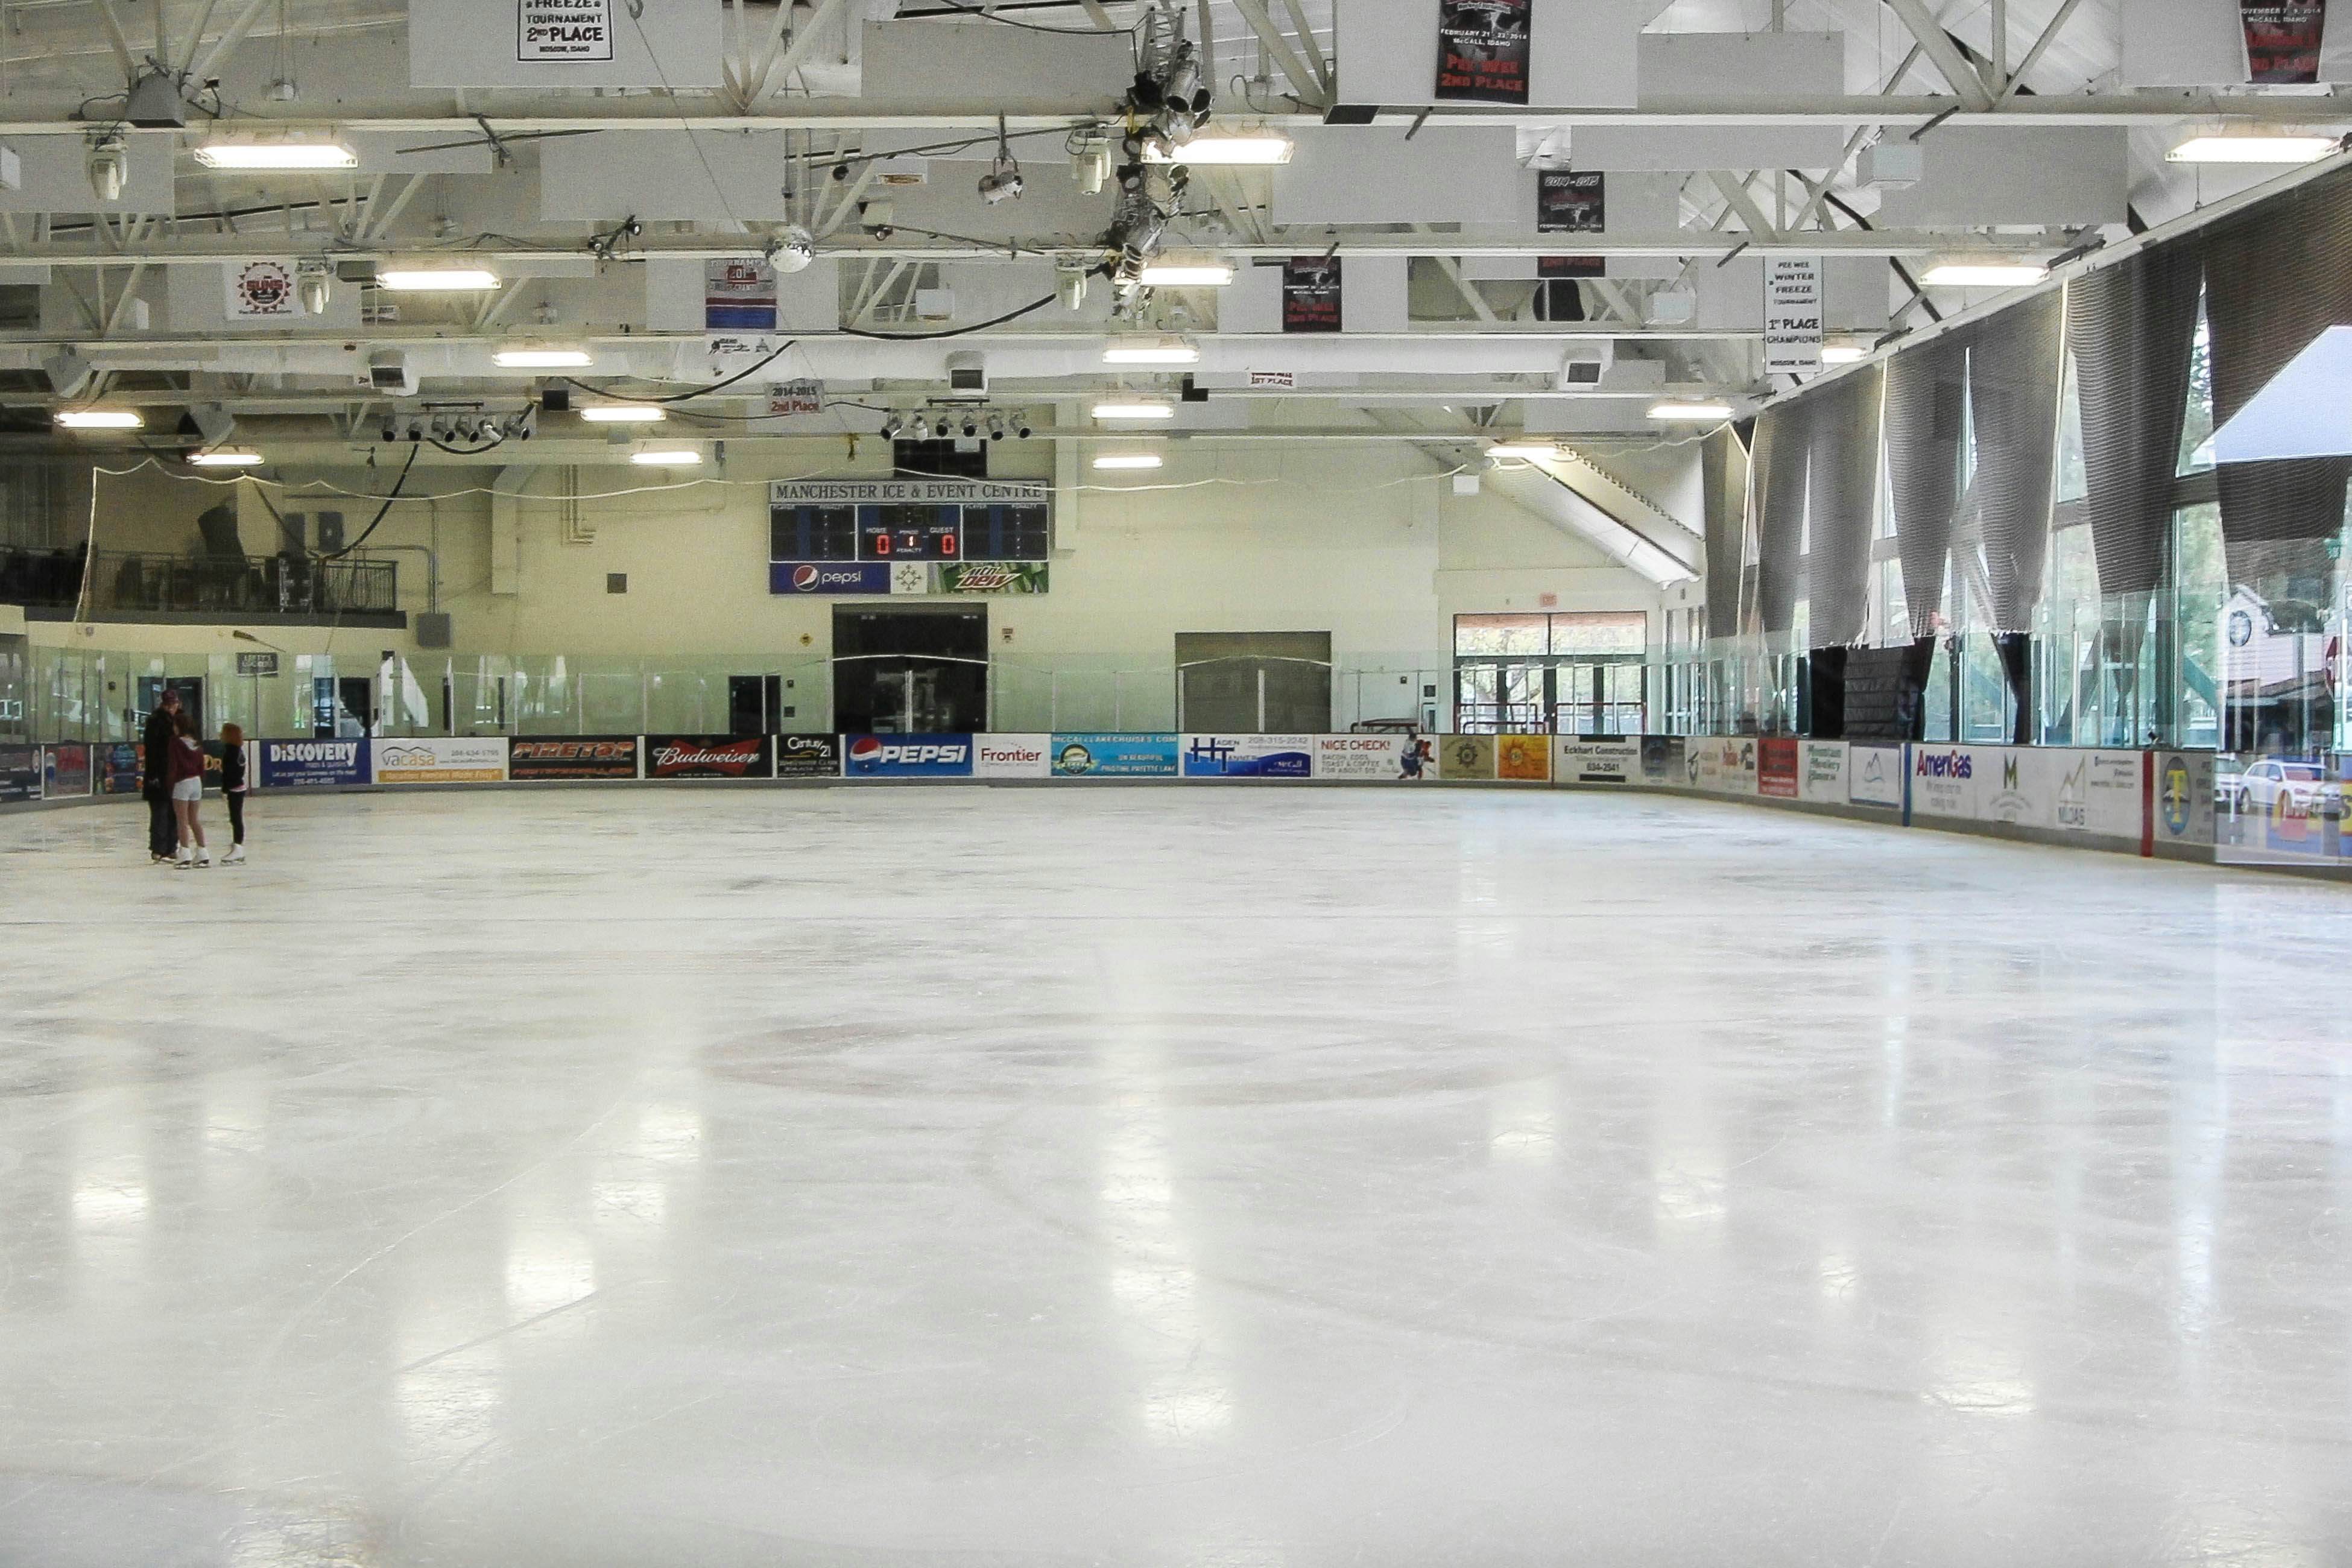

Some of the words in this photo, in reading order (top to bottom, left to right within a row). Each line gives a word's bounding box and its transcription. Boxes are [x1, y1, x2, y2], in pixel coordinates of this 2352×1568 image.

[526, 14, 602, 24] TOURNAMENT
[548, 27, 604, 42] PLACE
[1441, 28, 1479, 37] FEBRUARY
[1475, 75, 1525, 91] PLACE
[247, 280, 283, 291] SUNS
[1783, 318, 1819, 329] PLACE
[1767, 335, 1821, 344] CHAMPIONS
[776, 485, 877, 499] MANCHESTER
[883, 484, 905, 498] ICE
[911, 484, 921, 498] &
[927, 484, 977, 498] EVENT
[982, 484, 1042, 498] CENTRE
[877, 534, 890, 554] 0
[942, 534, 955, 554] 0
[822, 571, 862, 584] pepsi
[788, 737, 824, 750] Century
[1321, 739, 1347, 750] NICE
[1350, 739, 1390, 750] CHECK!
[1564, 745, 1593, 754] Eckhart
[1595, 745, 1638, 755] Construction
[653, 748, 760, 766] Budweiser
[820, 745, 831, 757] 21
[880, 745, 967, 763] PEPSI
[981, 748, 1042, 761] Frontier
[382, 754, 435, 766] vacasa
[1917, 750, 1972, 779] AmeriGas
